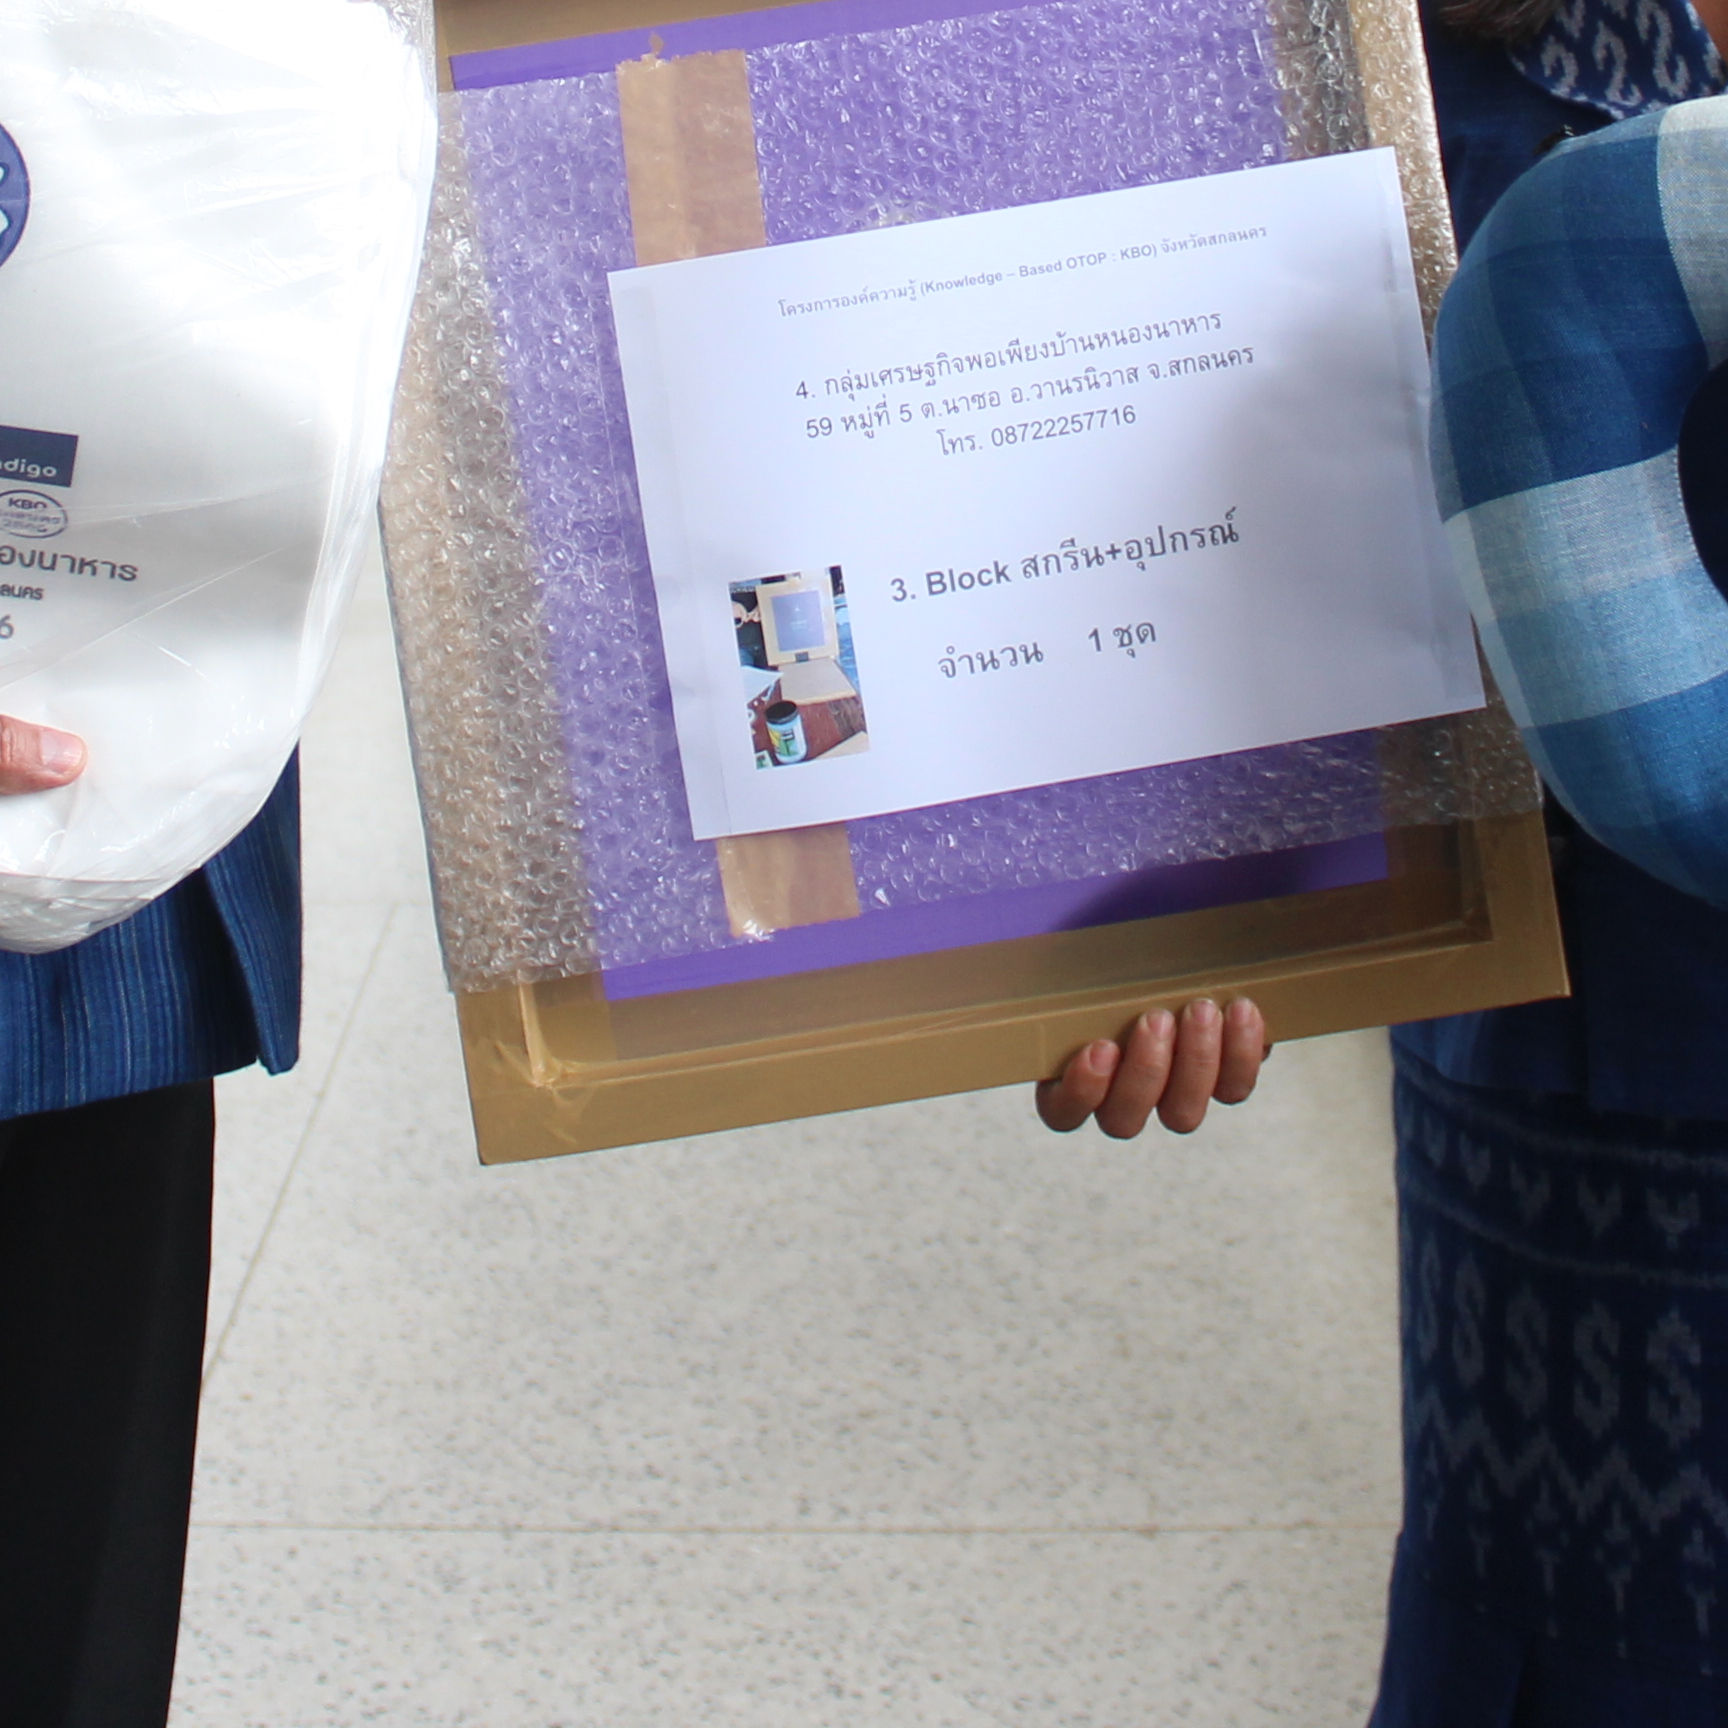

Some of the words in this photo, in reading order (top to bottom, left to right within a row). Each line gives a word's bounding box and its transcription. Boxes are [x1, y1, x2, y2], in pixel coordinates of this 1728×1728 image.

[778, 279, 918, 318] โครงการองค์ความรู้
[920, 270, 1003, 297] (Knowledge
[1019, 259, 1063, 278] Based
[1066, 251, 1107, 270] OTOP
[1120, 243, 1158, 261] KBO)
[1161, 225, 1268, 254] จังหวัดสกลนคร
[795, 380, 816, 400] 4.
[824, 312, 1222, 402] กลุ่มเศรษฐกิจพอเพียงบ้านหนองนาหาร
[805, 417, 833, 439] 59
[840, 393, 891, 439] หมู่ที่
[899, 403, 913, 423] 5
[1011, 365, 1140, 404] อ.วานรนิวาส
[1146, 346, 1255, 381] จ.สกลนคร
[936, 429, 983, 458] โทร.
[990, 404, 1136, 446] 08722257716
[890, 577, 917, 603] 3.
[925, 560, 1012, 597] Block
[1021, 506, 1240, 579] สกรีน+อุปกรณ์
[937, 640, 1044, 679] จำนวน
[1087, 627, 1103, 653] 1
[1112, 621, 1157, 658] ชุด
